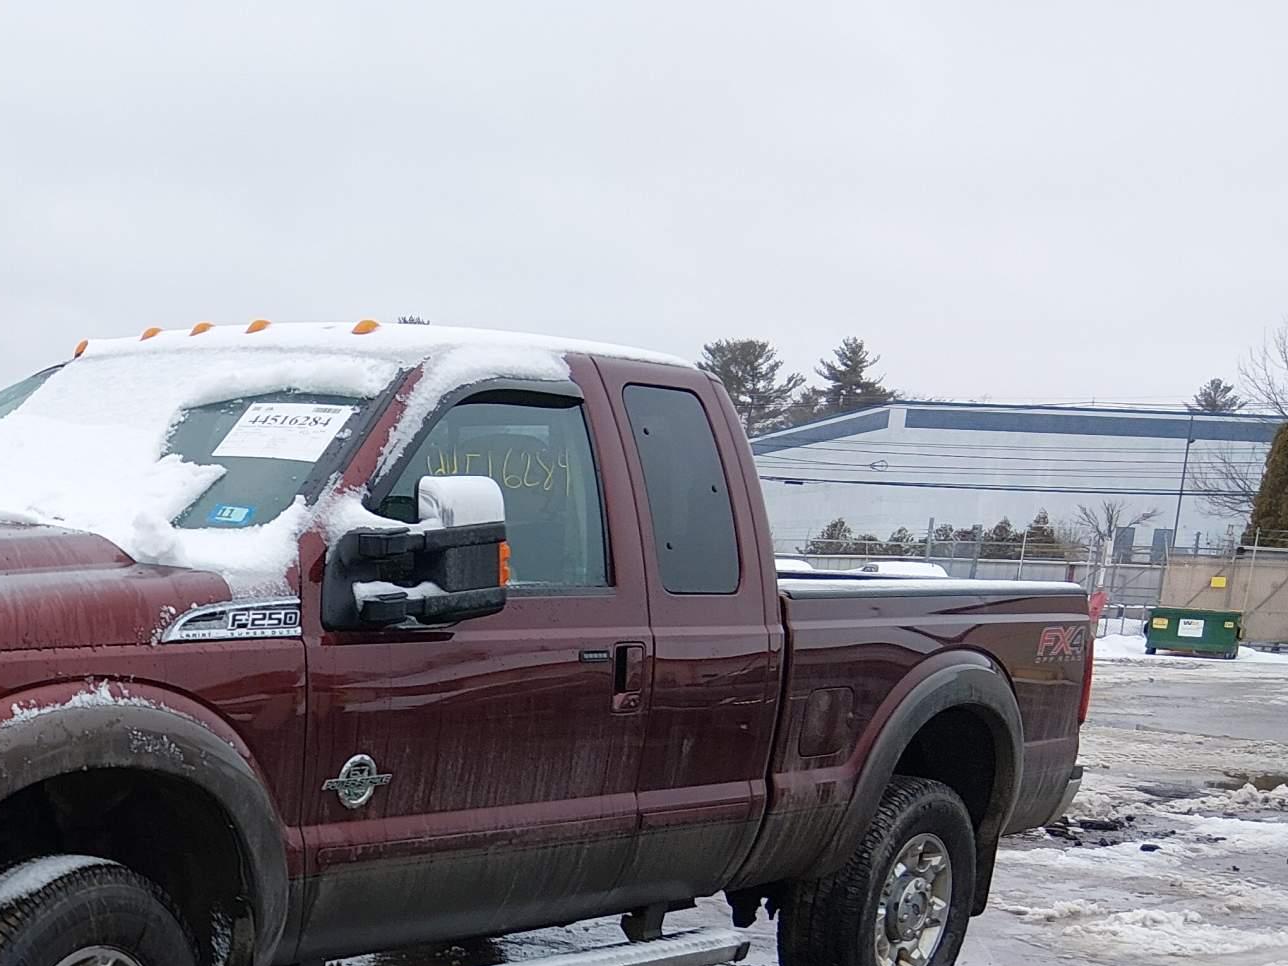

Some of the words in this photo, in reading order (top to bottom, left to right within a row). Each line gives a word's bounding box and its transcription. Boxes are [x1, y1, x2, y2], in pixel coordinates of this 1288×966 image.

[248, 414, 333, 427] 44516284
[227, 609, 300, 630] F-250
[1036, 626, 1086, 657] FX4
